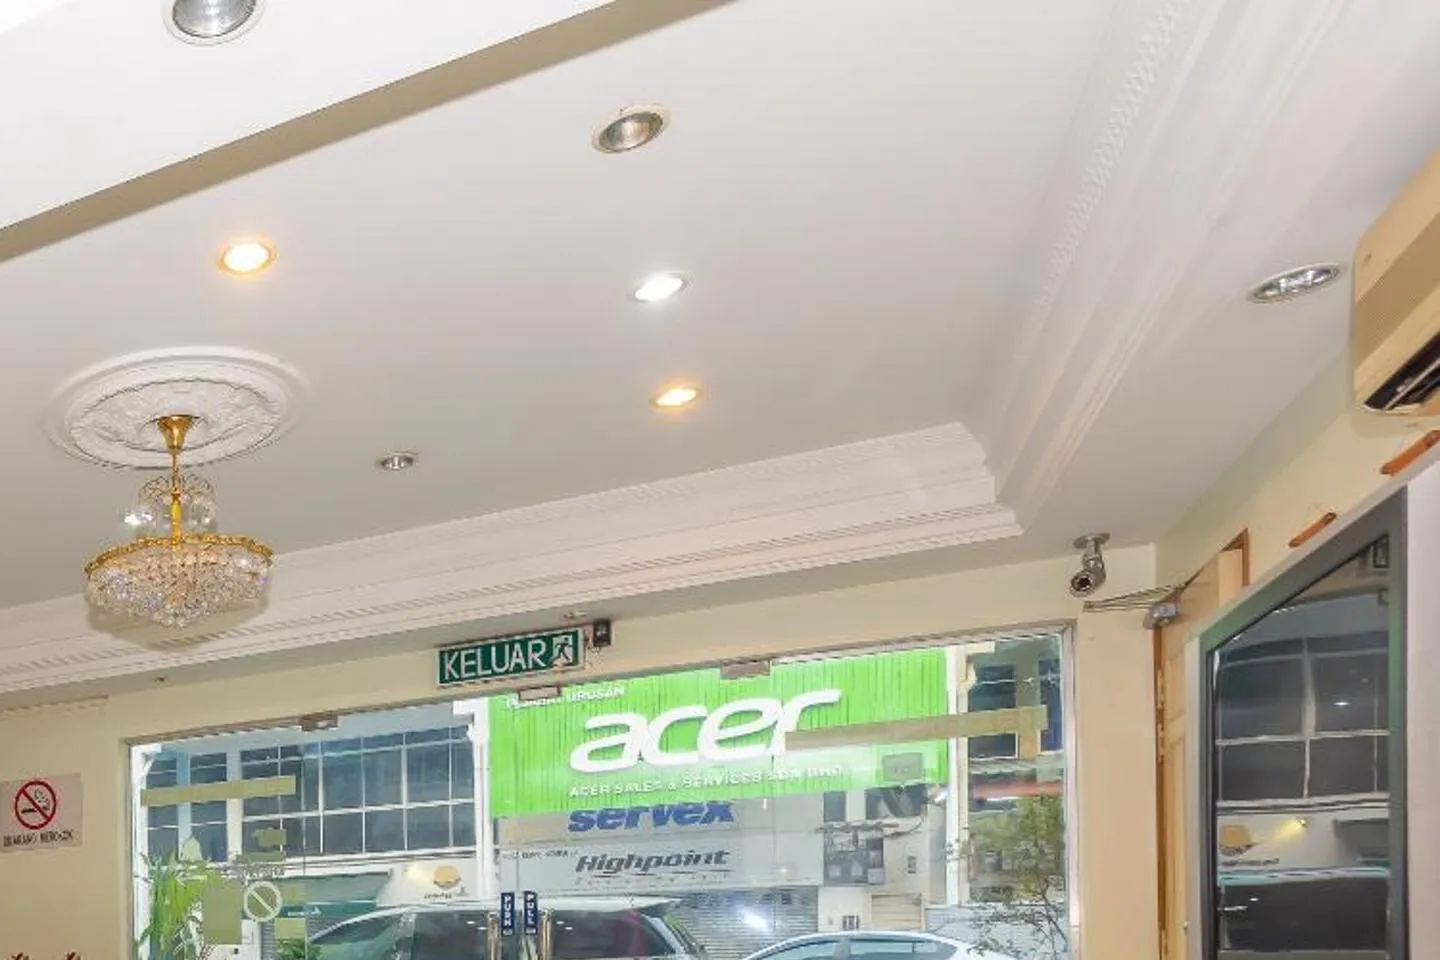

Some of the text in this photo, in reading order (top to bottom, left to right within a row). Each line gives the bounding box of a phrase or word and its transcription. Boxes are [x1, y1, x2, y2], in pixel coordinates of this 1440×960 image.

[444, 640, 547, 681] KELUAR
[569, 688, 842, 773] acer
[569, 783, 610, 797] ACER
[615, 780, 662, 795] SALES
[684, 772, 762, 790] SERVICES
[568, 801, 734, 832] servex
[575, 850, 731, 874] Highpoint
